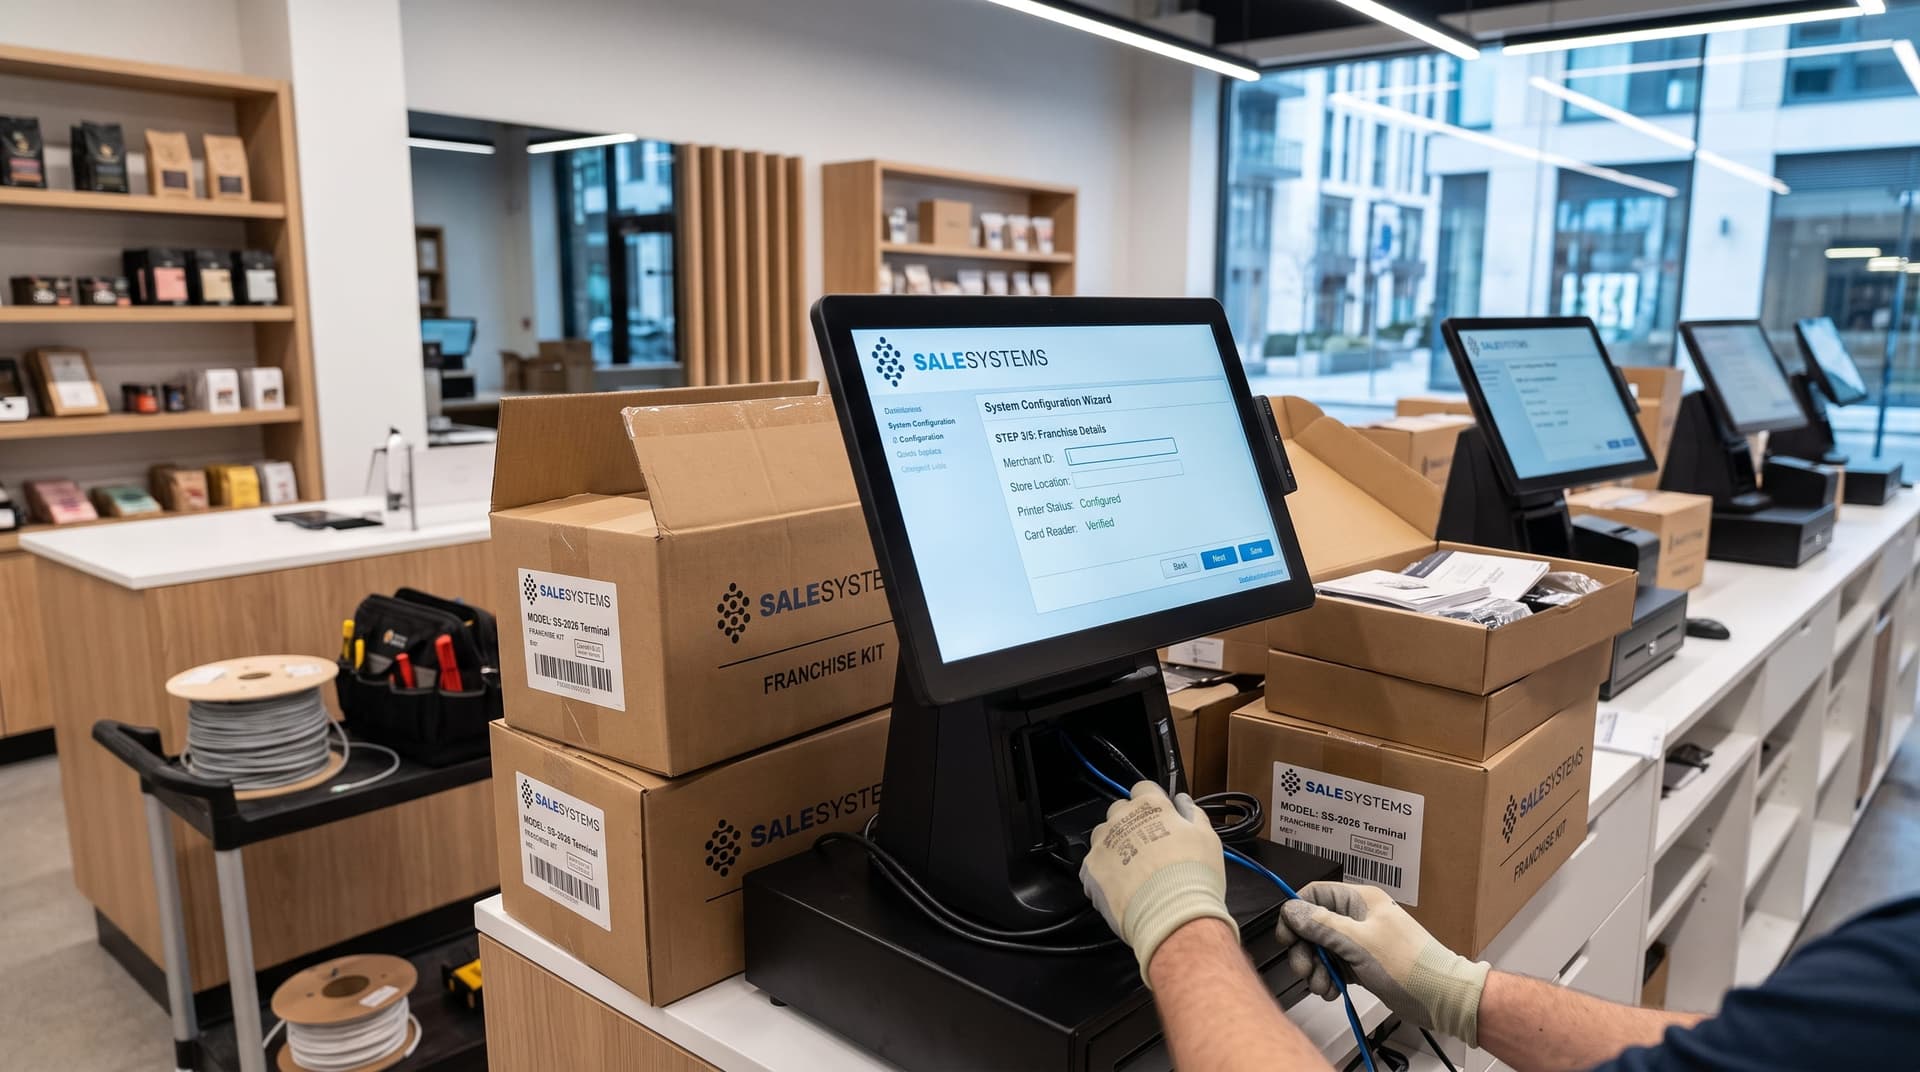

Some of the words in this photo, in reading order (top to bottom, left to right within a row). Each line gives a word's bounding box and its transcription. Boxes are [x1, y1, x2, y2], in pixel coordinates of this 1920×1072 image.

[913, 349, 1048, 371] SALESYSTEMS
[984, 402, 1020, 414] System
[1021, 397, 1081, 410] Configuration
[1081, 394, 1112, 406] Wizard
[888, 422, 912, 430] System
[912, 418, 956, 428] Configuration
[995, 431, 1018, 443] STEP
[1020, 430, 1037, 441] 3/5:
[1038, 427, 1078, 440] Franchise
[1079, 424, 1107, 436] Details
[1002, 455, 1042, 468] Merchant
[1043, 453, 1055, 464] ID:
[1010, 481, 1032, 493] Store
[1033, 477, 1071, 490] Location:
[1017, 504, 1045, 517] Printer
[1079, 493, 1121, 509] Configured
[1024, 529, 1045, 541] Card
[1046, 525, 1078, 537] Reader:
[1085, 517, 1115, 531] Verified
[540, 584, 611, 608] SALESYSTEMS
[759, 568, 885, 617] SALESYSTE
[552, 617, 579, 631] SS-2026
[580, 622, 610, 637] Terminal
[763, 651, 857, 695] FRANCHISE
[861, 643, 885, 665] KIT
[1520, 746, 1584, 818] SALESYSTEMS
[1305, 780, 1413, 816] SALESYSTEMS
[535, 792, 600, 832] SALESYSTEMS
[750, 783, 882, 848] SALESYSTE
[1280, 801, 1319, 818] MODEL:
[1321, 811, 1361, 829] SS-2026
[1363, 821, 1407, 840] Terminal
[571, 837, 599, 858] Terminal
[1513, 830, 1555, 884] FRANCHISE
[1554, 818, 1567, 840] KIT
